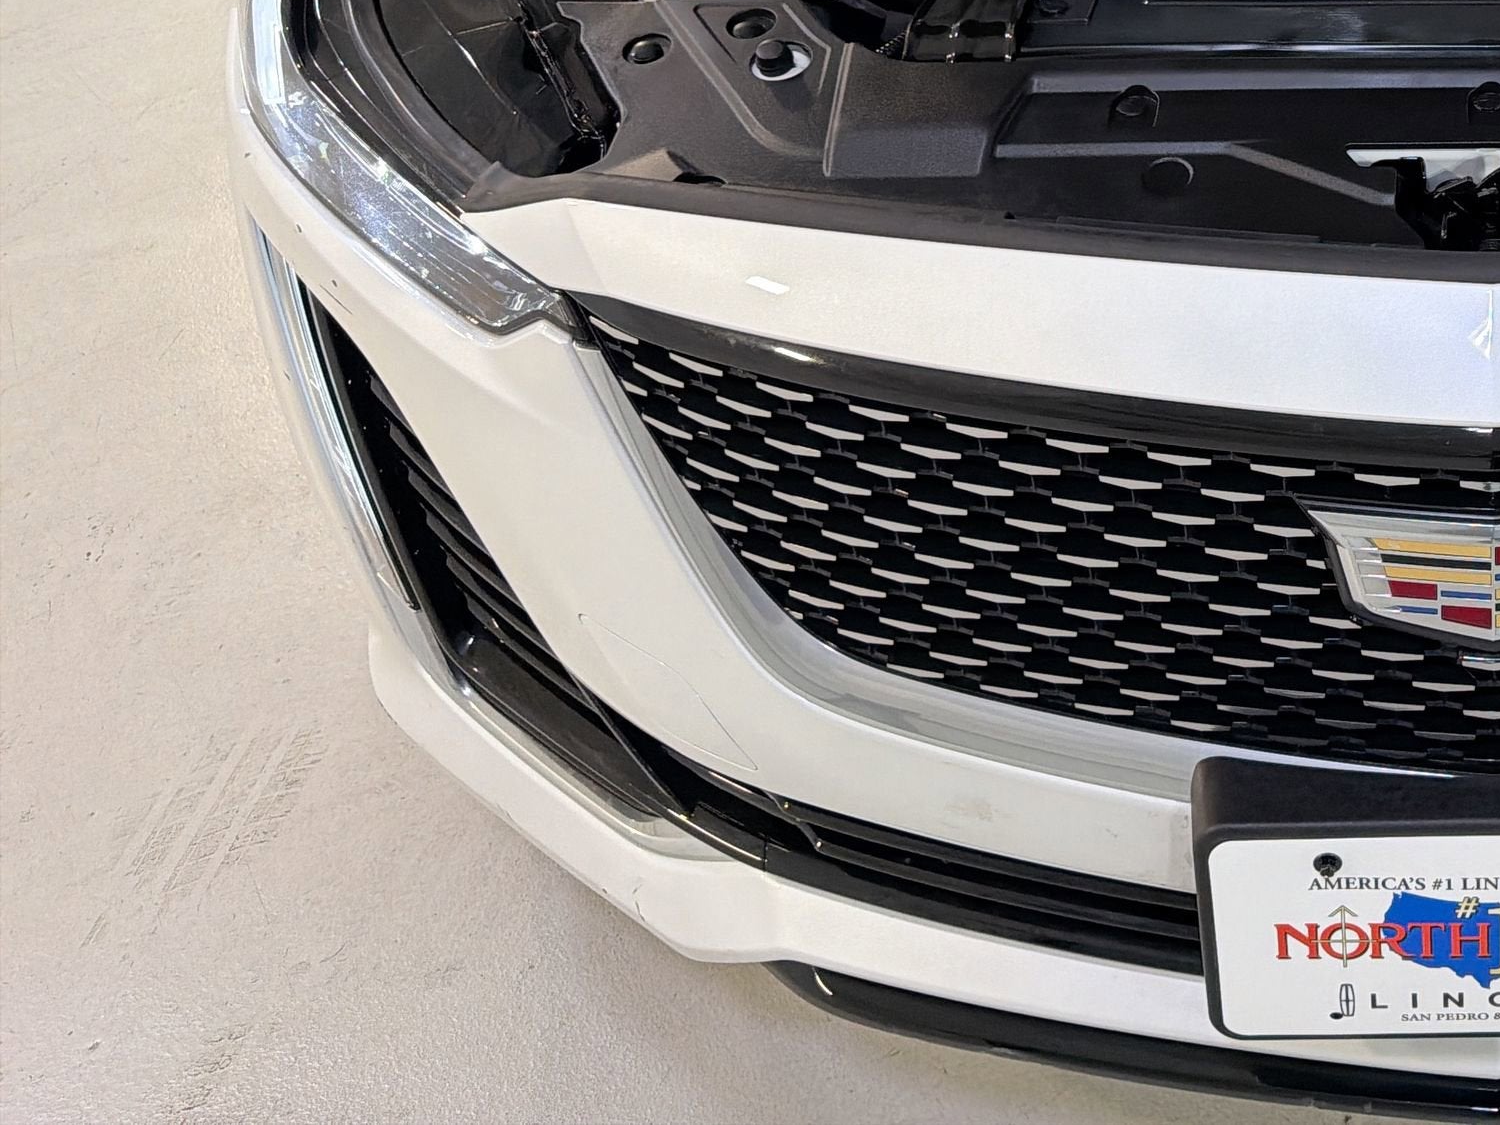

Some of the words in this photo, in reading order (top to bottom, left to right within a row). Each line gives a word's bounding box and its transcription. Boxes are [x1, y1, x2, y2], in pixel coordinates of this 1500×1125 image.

[1308, 876, 1426, 891] AMERICA'S
[1431, 877, 1454, 891] #1
[1273, 921, 1492, 960] NORTH
[1401, 1013, 1431, 1022] SAN
[1436, 1011, 1490, 1021] PEDRO
